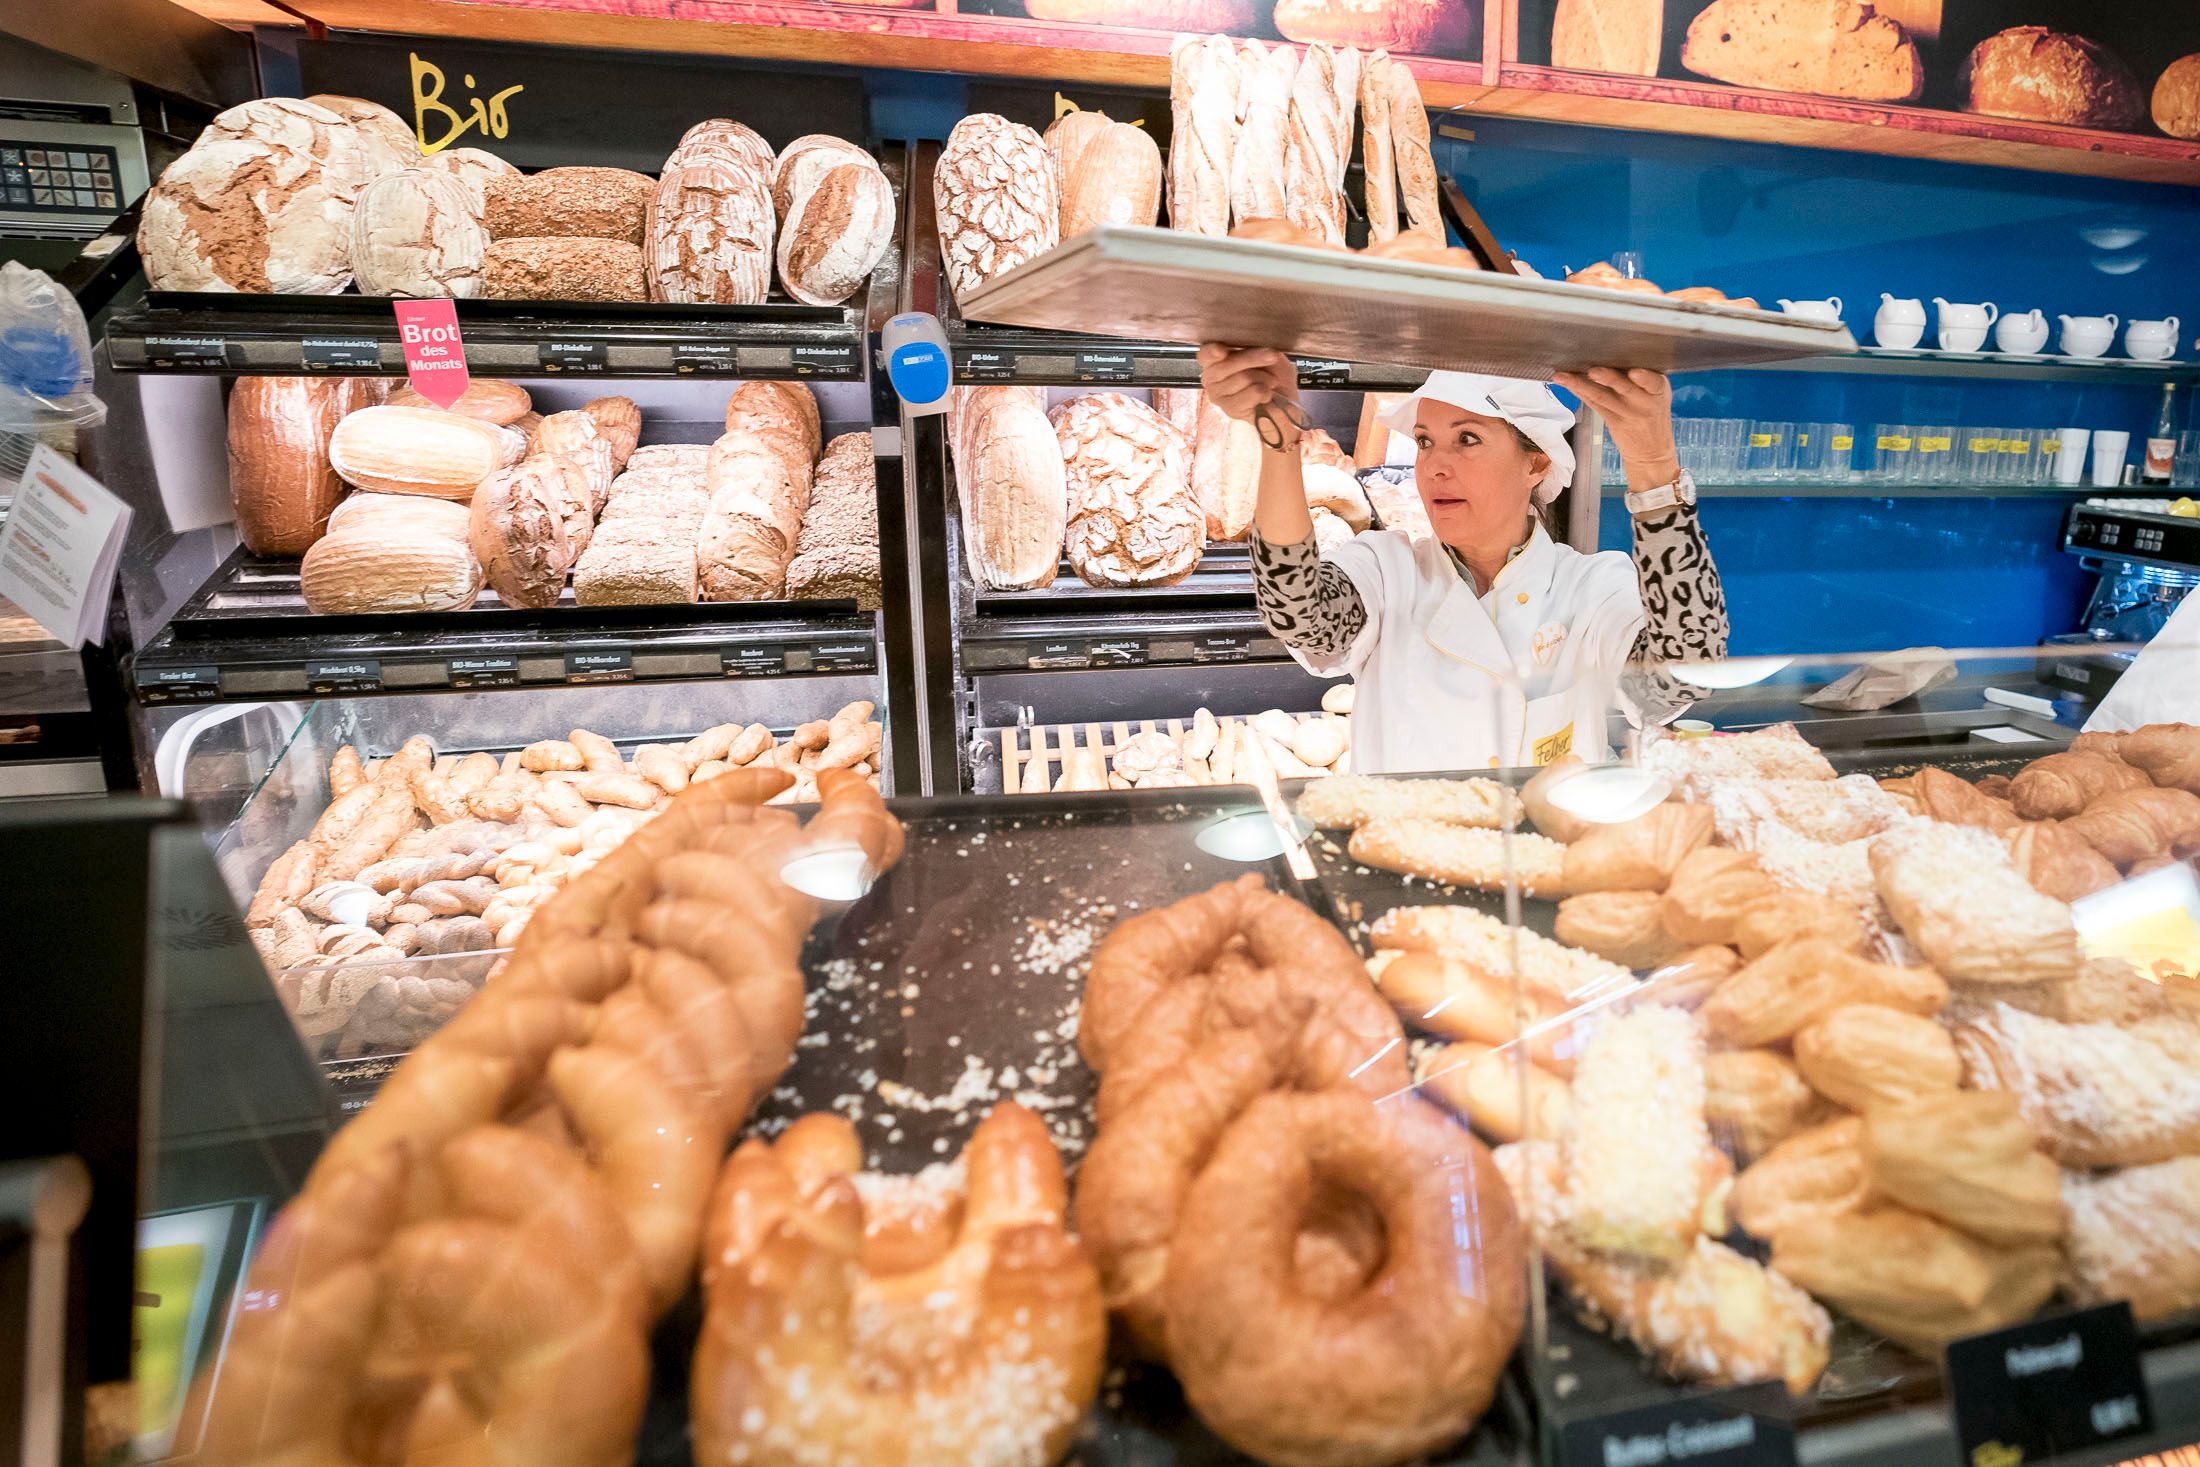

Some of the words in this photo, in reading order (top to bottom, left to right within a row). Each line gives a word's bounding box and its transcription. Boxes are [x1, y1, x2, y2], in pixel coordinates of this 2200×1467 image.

[409, 51, 524, 157] Bio
[403, 324, 458, 343] Brot
[420, 345, 448, 356] des
[410, 359, 463, 371] Monats
[1535, 735, 1571, 765] Felber
